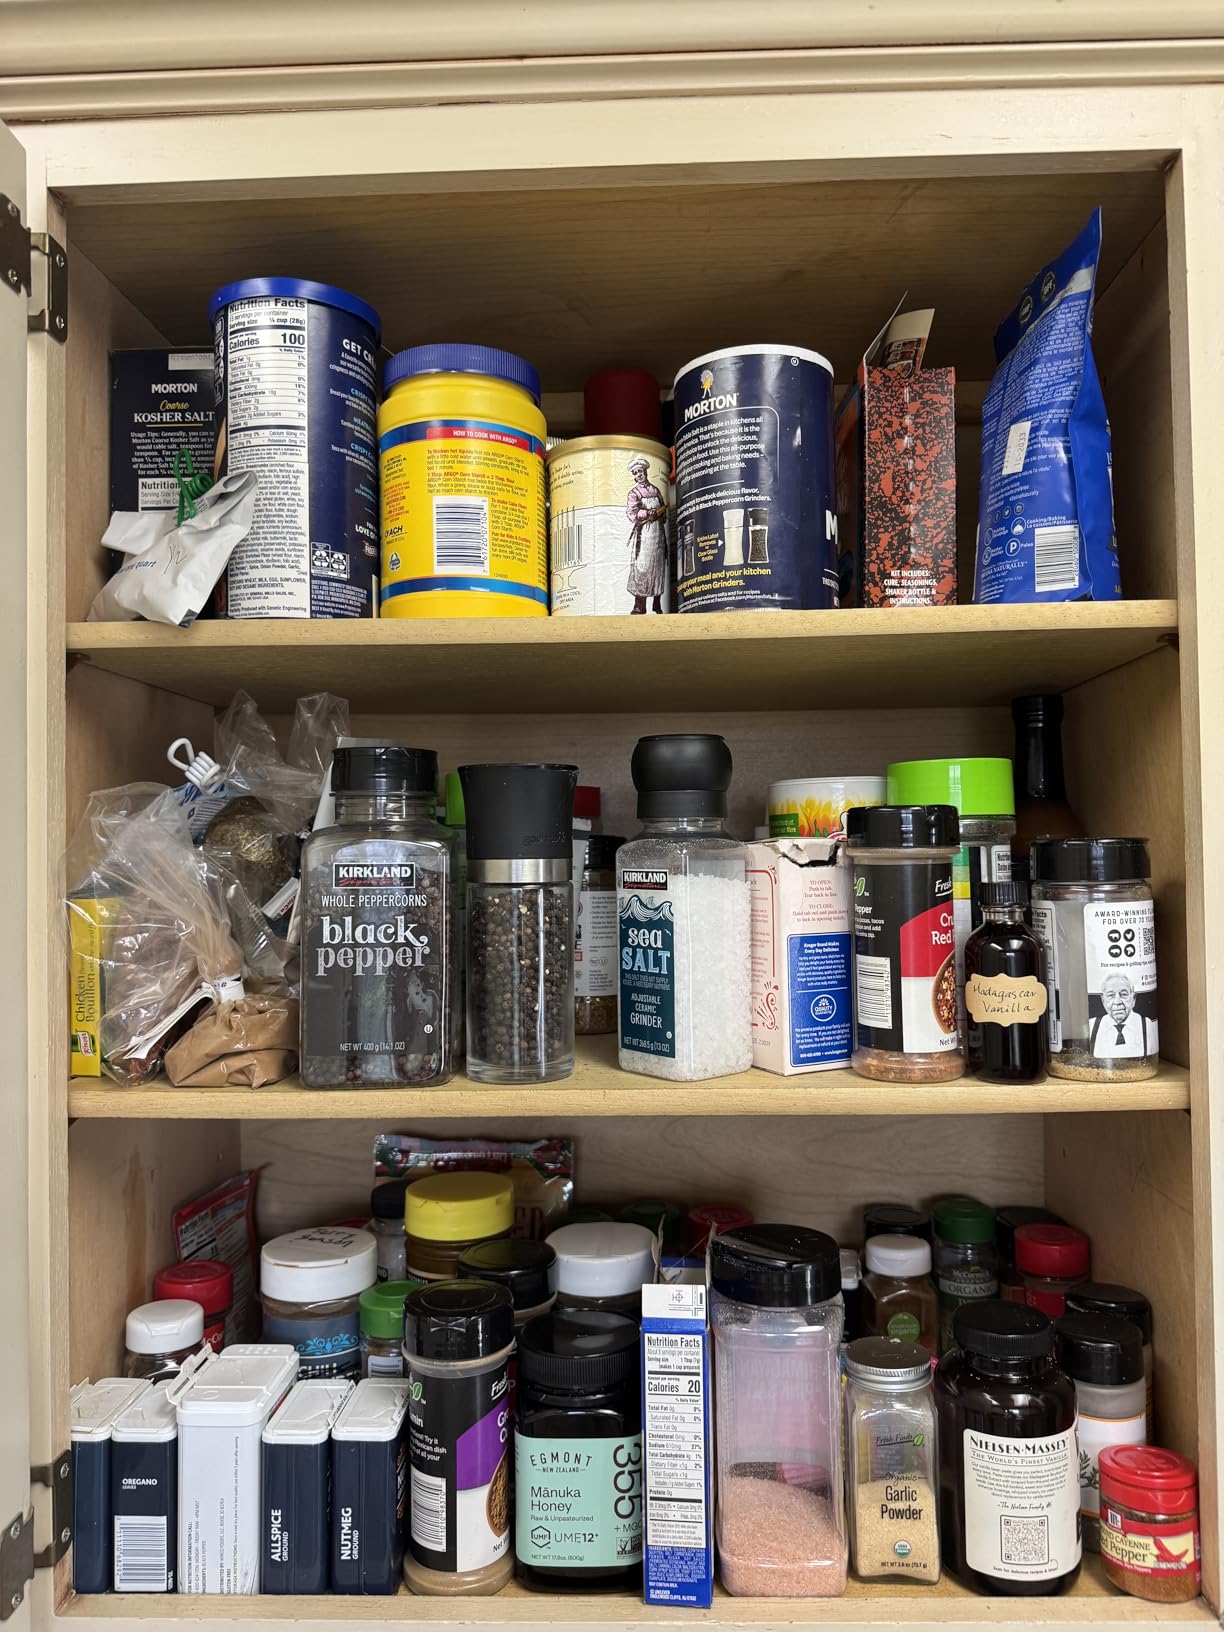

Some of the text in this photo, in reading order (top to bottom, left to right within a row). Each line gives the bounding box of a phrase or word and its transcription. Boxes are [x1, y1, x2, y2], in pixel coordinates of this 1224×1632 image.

[230, 298, 306, 313] Nutrition Facts
[229, 333, 305, 350] Calories 100
[343, 338, 361, 355] GET
[152, 383, 198, 394] MORTON
[160, 400, 190, 411] Coarse
[684, 393, 737, 422] MORTON
[134, 412, 215, 423] KOSHER SALT
[730, 417, 755, 425] kitchens
[141, 481, 180, 490] Nutrition
[697, 572, 711, 582] meal
[712, 570, 725, 578] and
[726, 569, 742, 578] your
[712, 579, 745, 588] Grinders.
[338, 866, 411, 878] KIRKLAND
[624, 872, 666, 883] KIRKLAND
[321, 895, 427, 907] WHOLE PEPPERCORNS
[1095, 908, 1147, 917] AWARD-WINNING
[320, 916, 428, 946] black
[628, 928, 662, 948] sea
[931, 930, 952, 944] Red
[315, 945, 430, 976] pepper
[622, 947, 670, 974] SALT
[75, 975, 86, 1022] Chicken
[86, 973, 96, 1022] Bouillon
[631, 993, 661, 1004] ADJUSTABLE
[635, 1003, 656, 1013] CERAMIC
[983, 1001, 1034, 1013] Vanilla
[630, 1012, 662, 1028] GRINDER
[648, 1336, 700, 1347] Nutrition Facts
[648, 1380, 700, 1393] Calories 20
[530, 1452, 592, 1467] EGMONT
[885, 1472, 917, 1486] Organic
[531, 1486, 581, 1498] Mānuka
[885, 1486, 917, 1502] Garlic
[531, 1500, 572, 1514] Honey
[881, 1504, 923, 1520] Powder
[270, 1509, 281, 1562] ALLSPICE
[340, 1507, 352, 1560] NUTMEG
[1115, 1536, 1150, 1550] CAYENNE
[1110, 1542, 1147, 1564] Pepper
